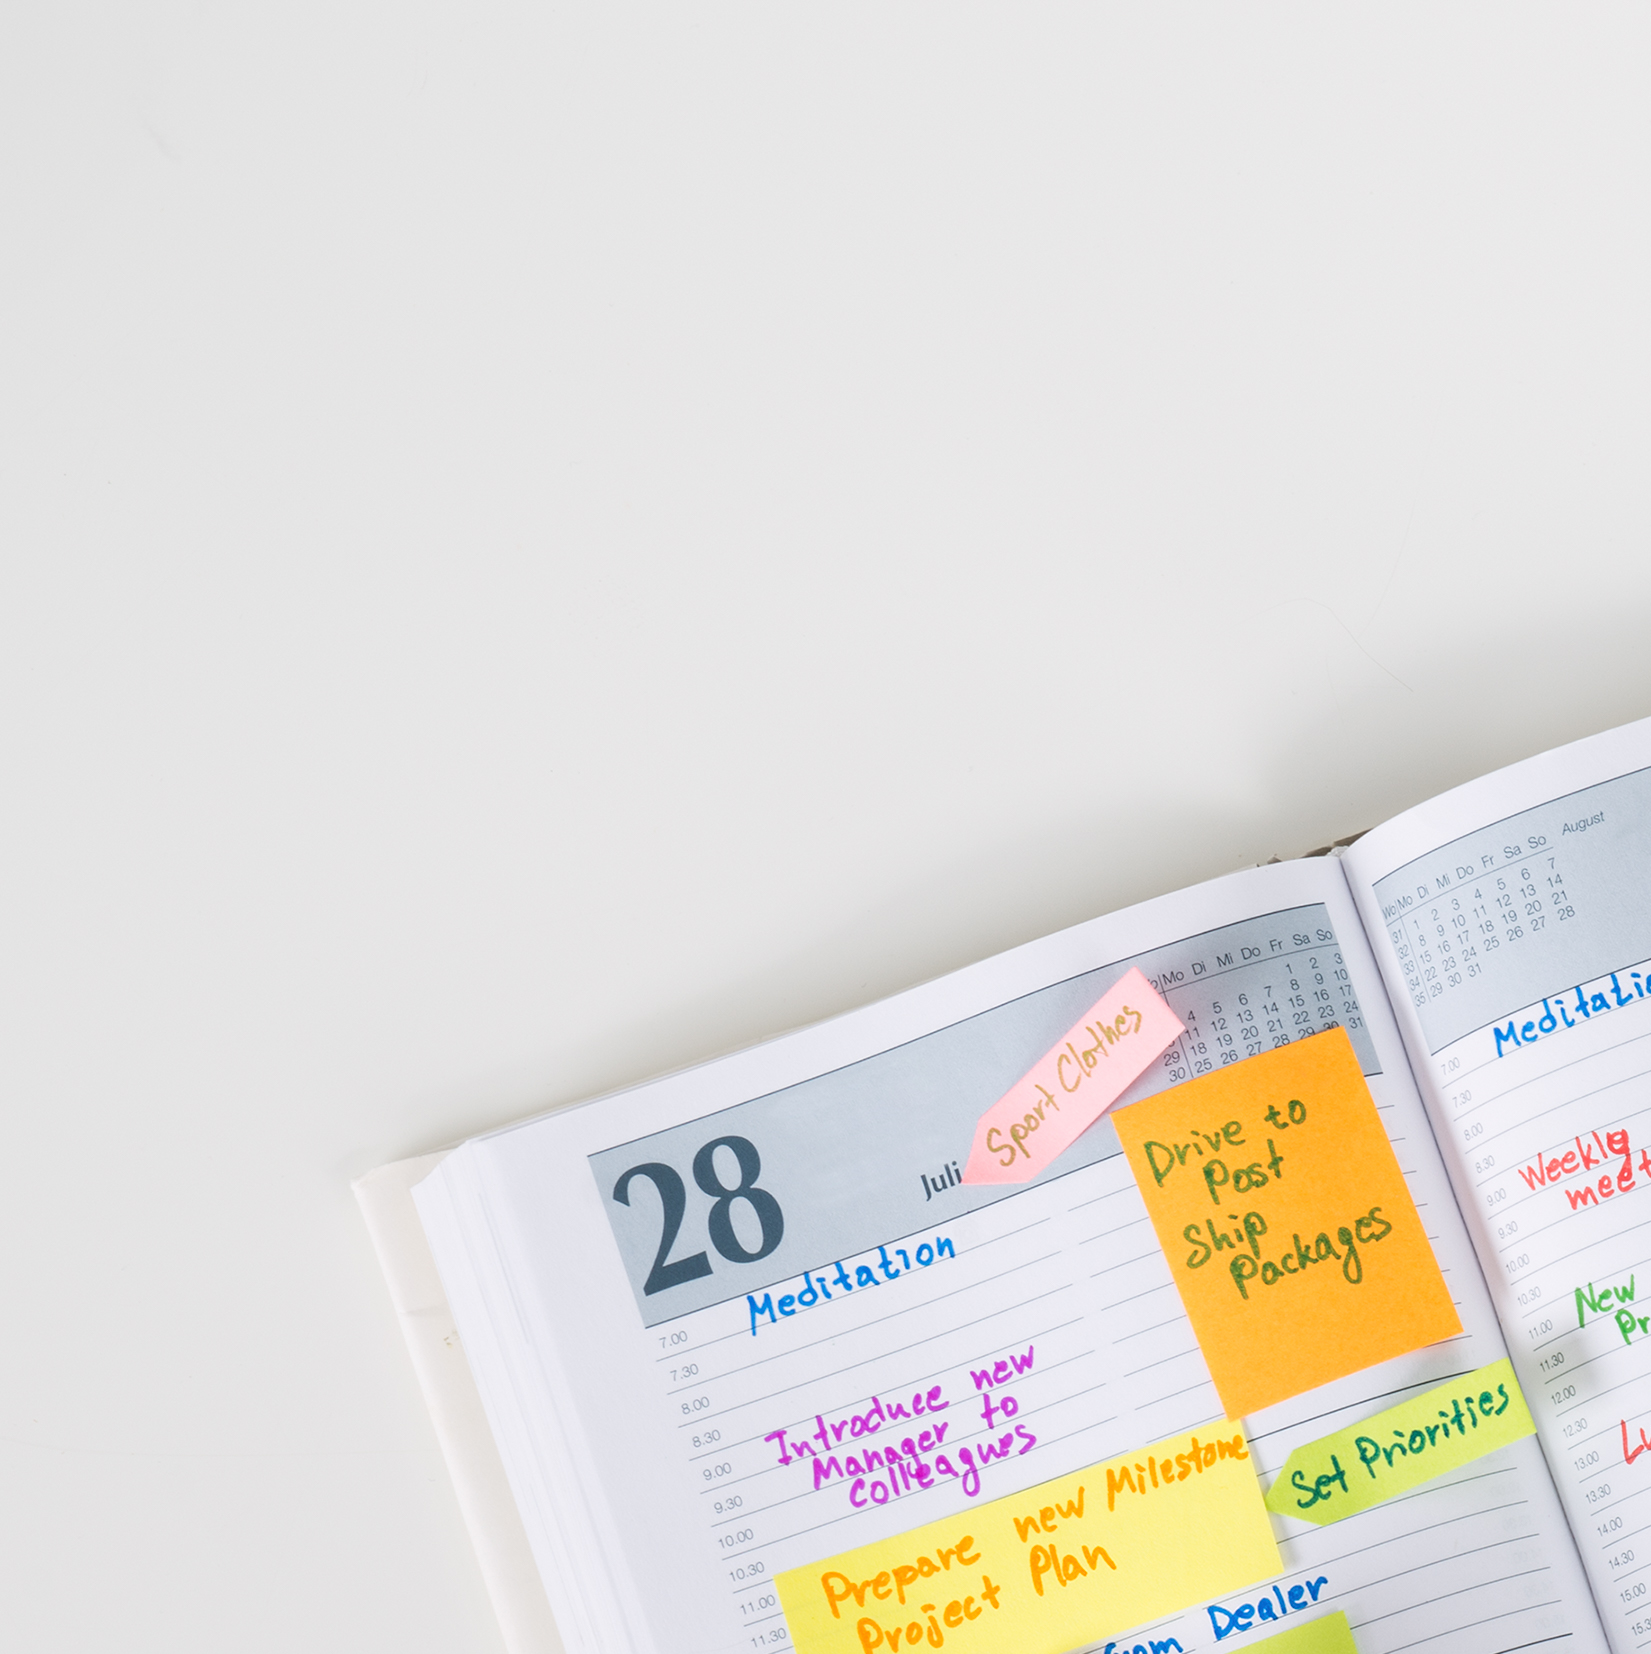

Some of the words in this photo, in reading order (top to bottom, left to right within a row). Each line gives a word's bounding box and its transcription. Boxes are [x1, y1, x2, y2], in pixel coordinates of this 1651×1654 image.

[1562, 811, 1605, 836] August
[1162, 969, 1185, 985] Mo
[1191, 961, 1207, 976] Di
[1216, 952, 1234, 967] Mi
[1240, 947, 1261, 961] Do
[1269, 939, 1283, 952] Fr
[1292, 933, 1311, 947] Sa
[1316, 928, 1333, 942] So
[987, 1084, 1060, 1167] Sport
[1057, 1005, 1142, 1093] Clothes
[1144, 1121, 1246, 1187] Drive
[1264, 1100, 1306, 1130] to
[1203, 1139, 1284, 1205] Post
[1517, 1129, 1632, 1191] Weekly
[921, 1160, 963, 1201] Juli
[613, 1135, 784, 1297] 28
[1183, 1212, 1267, 1269] Ship
[747, 1236, 956, 1336] Meditation
[1230, 1207, 1392, 1300] Packages
[1574, 1273, 1635, 1329] New
[659, 1330, 688, 1349] 7.00
[1539, 1352, 1565, 1372] 11.30
[764, 1385, 949, 1466] Introduce
[970, 1345, 1034, 1390] new
[813, 1422, 948, 1490] Manager
[981, 1393, 1018, 1429] to
[1291, 1454, 1348, 1509] Set
[1355, 1383, 1509, 1479] Priorities
[821, 1535, 981, 1618] Prepare
[1014, 1486, 1085, 1542] new
[1106, 1434, 1250, 1511] Milestone
[1030, 1543, 1117, 1596] Plan
[1207, 1574, 1328, 1642] Dealer
